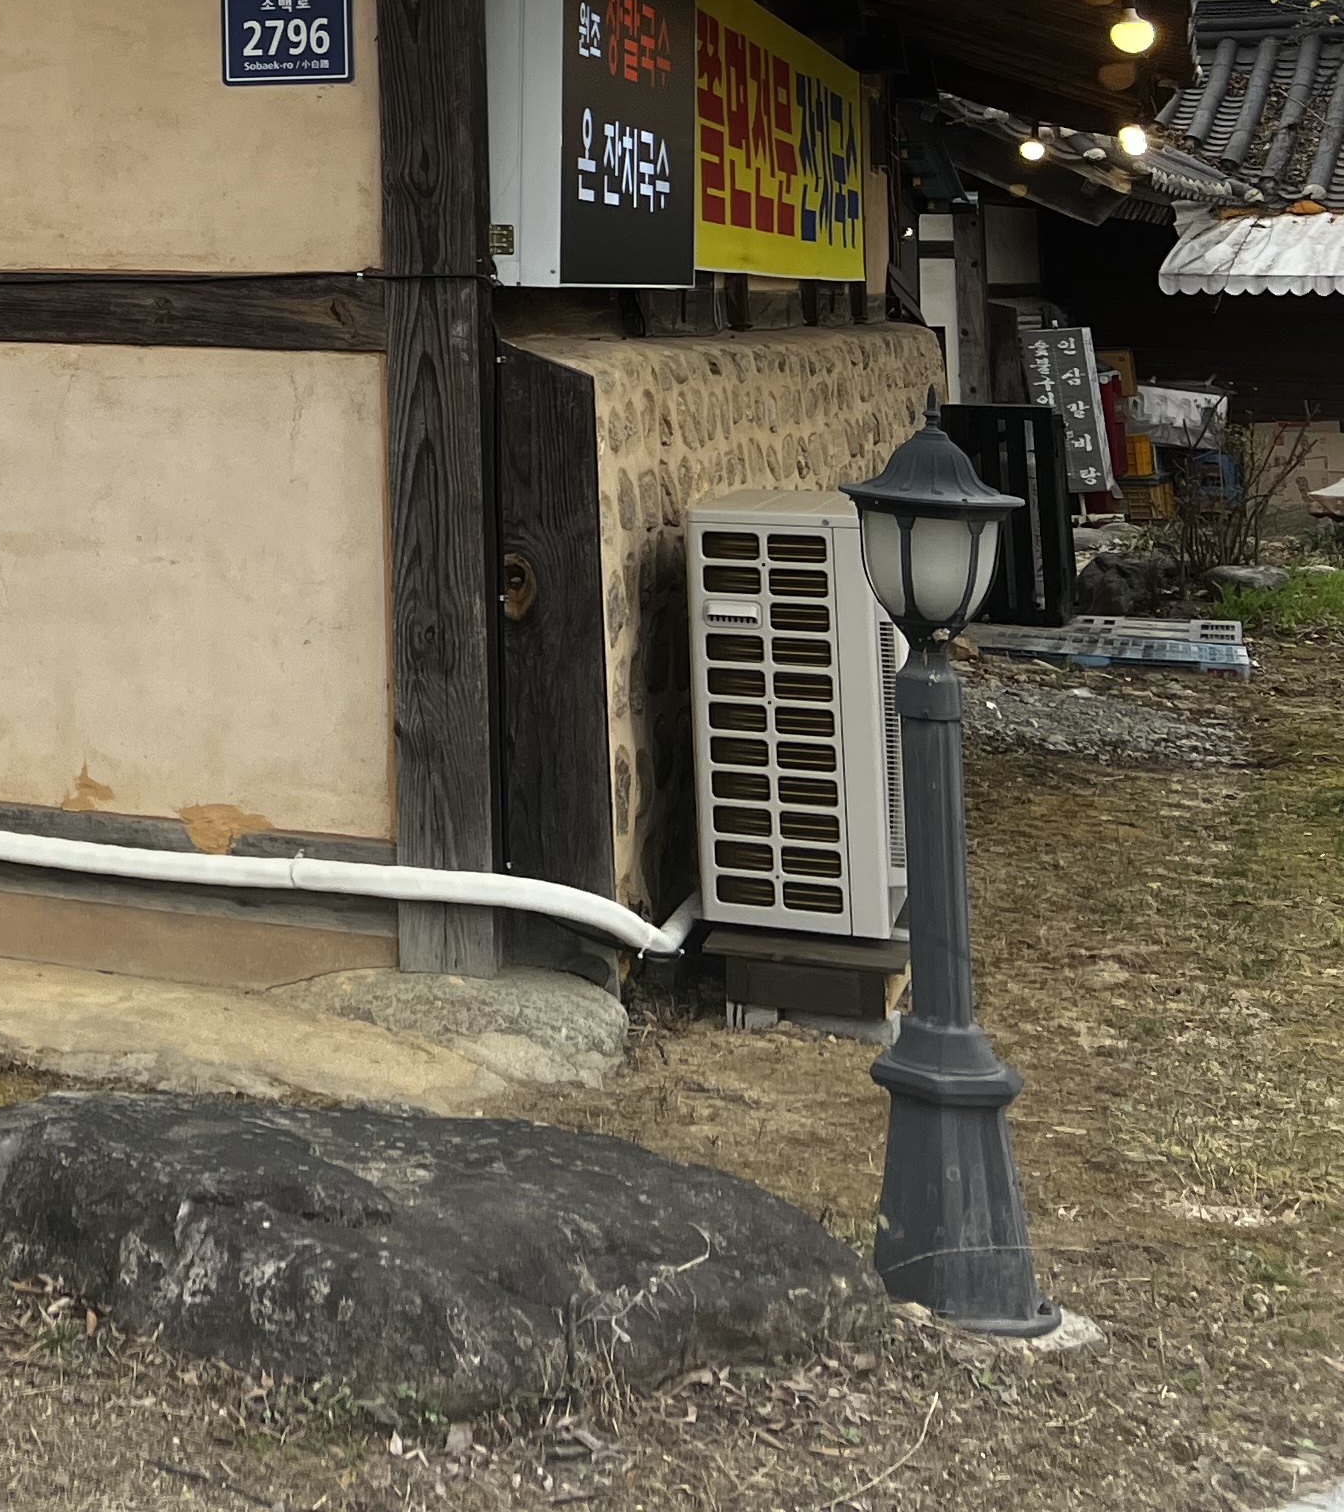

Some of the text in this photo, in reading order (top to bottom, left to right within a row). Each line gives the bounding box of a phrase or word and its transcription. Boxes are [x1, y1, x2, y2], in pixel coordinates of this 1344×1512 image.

[243, 17, 330, 57] 2796
[578, 2, 601, 58] 원조
[244, 59, 294, 71] Sobaek-ro
[577, 108, 671, 213] 온 잔치국수
